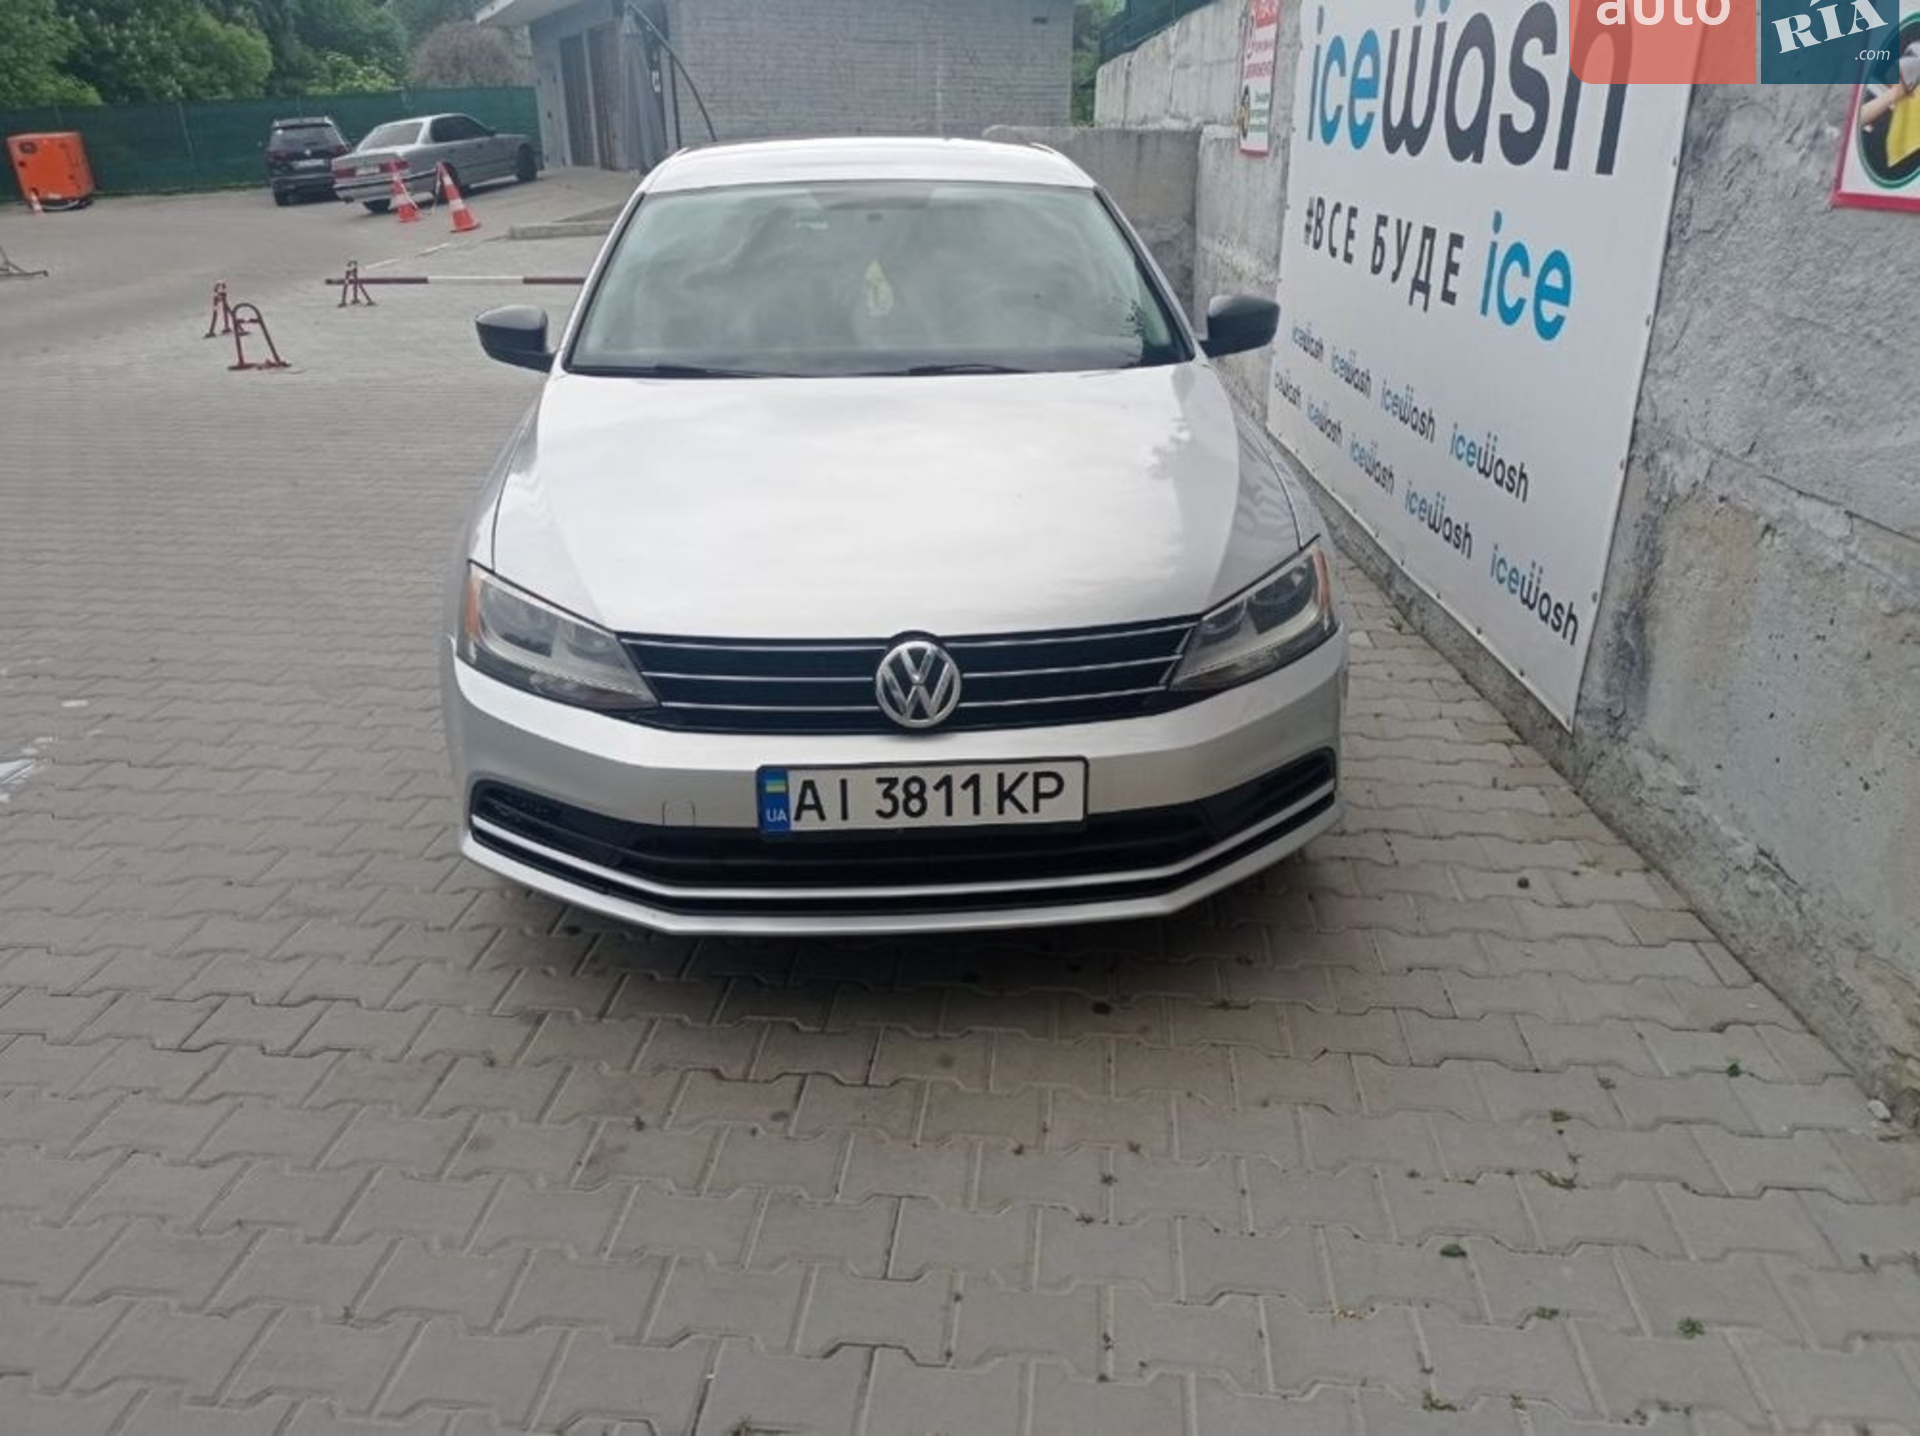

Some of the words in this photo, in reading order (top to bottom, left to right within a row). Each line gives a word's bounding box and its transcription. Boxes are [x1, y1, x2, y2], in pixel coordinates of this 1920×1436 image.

[1370, 213, 1465, 313] БУДЕ
[1479, 210, 1572, 341] ice
[766, 810, 787, 823] UA
[794, 778, 848, 822] AI
[875, 773, 981, 819] 3811
[997, 770, 1065, 816] KP
